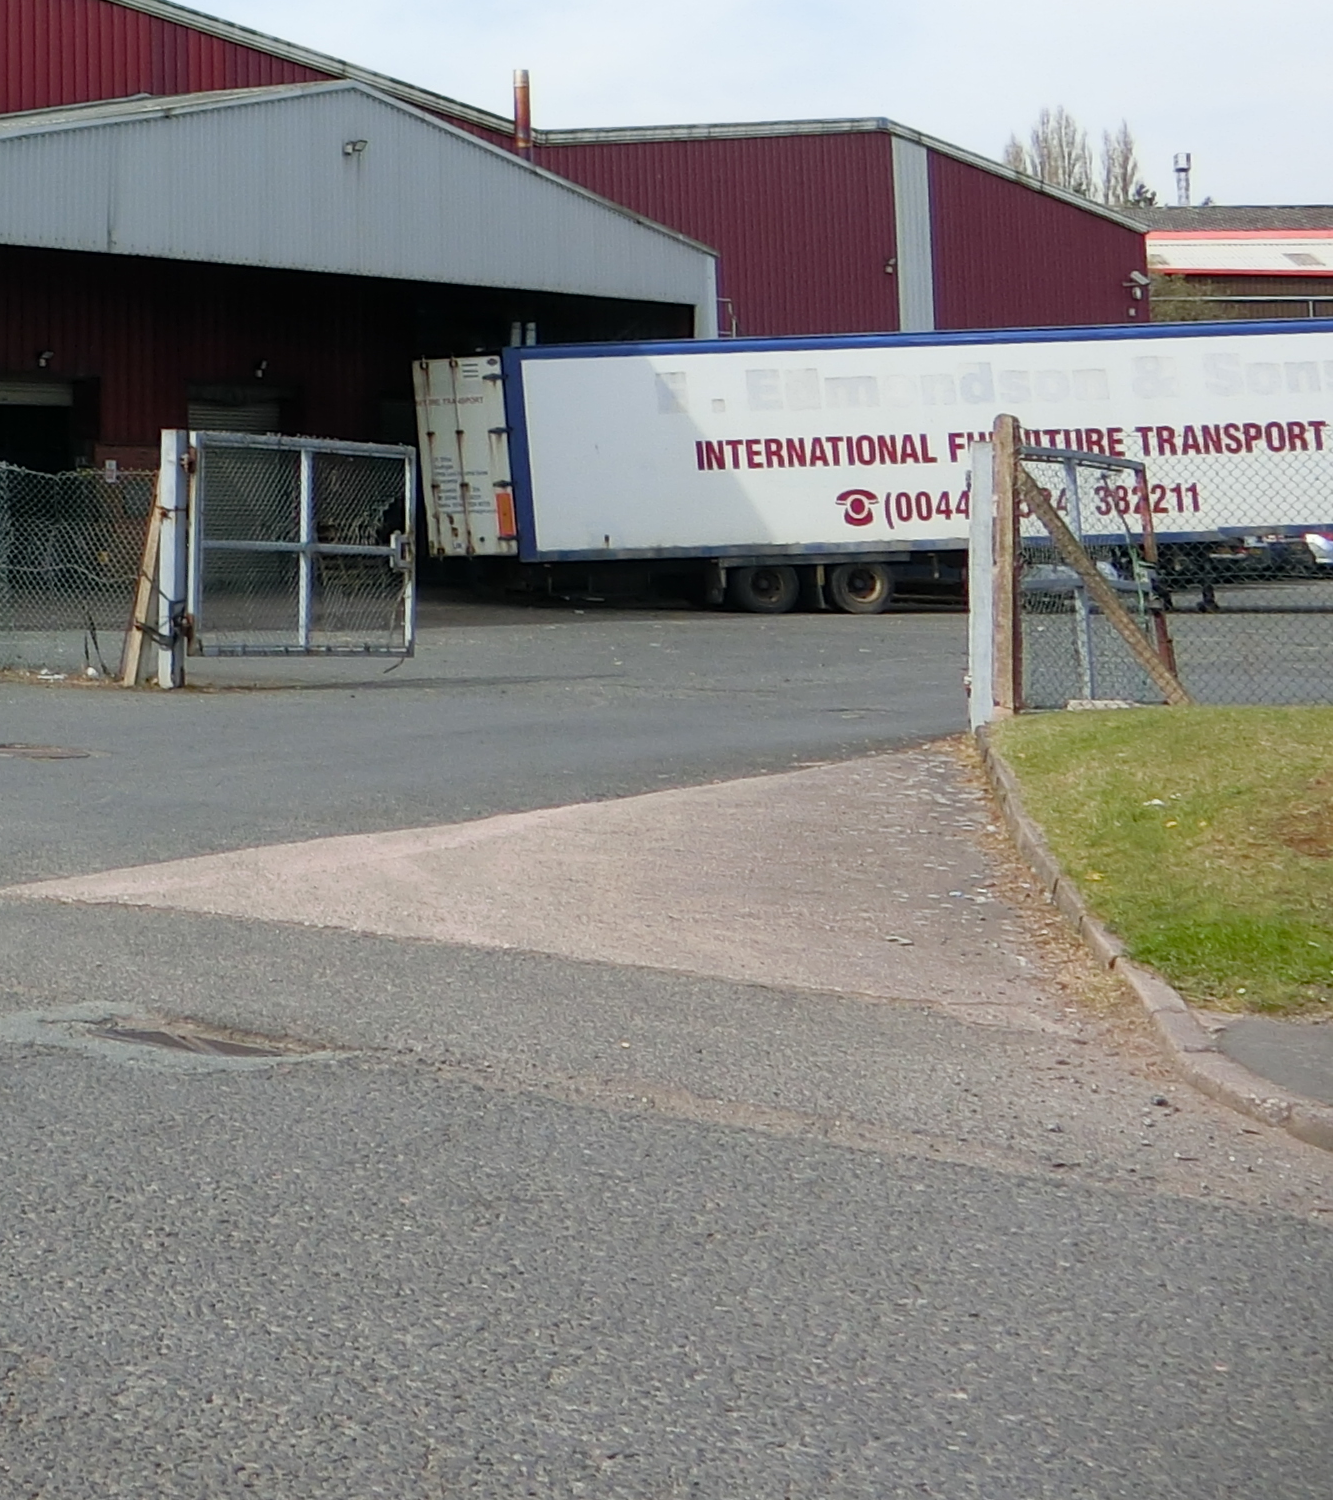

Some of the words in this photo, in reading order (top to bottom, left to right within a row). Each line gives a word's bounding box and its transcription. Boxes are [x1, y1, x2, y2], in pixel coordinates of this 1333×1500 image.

[1133, 354, 1181, 401] &
[695, 433, 938, 472] INTERNATIONAL
[1135, 420, 1326, 457] TRANSPORT
[1093, 481, 1201, 517] 382211
